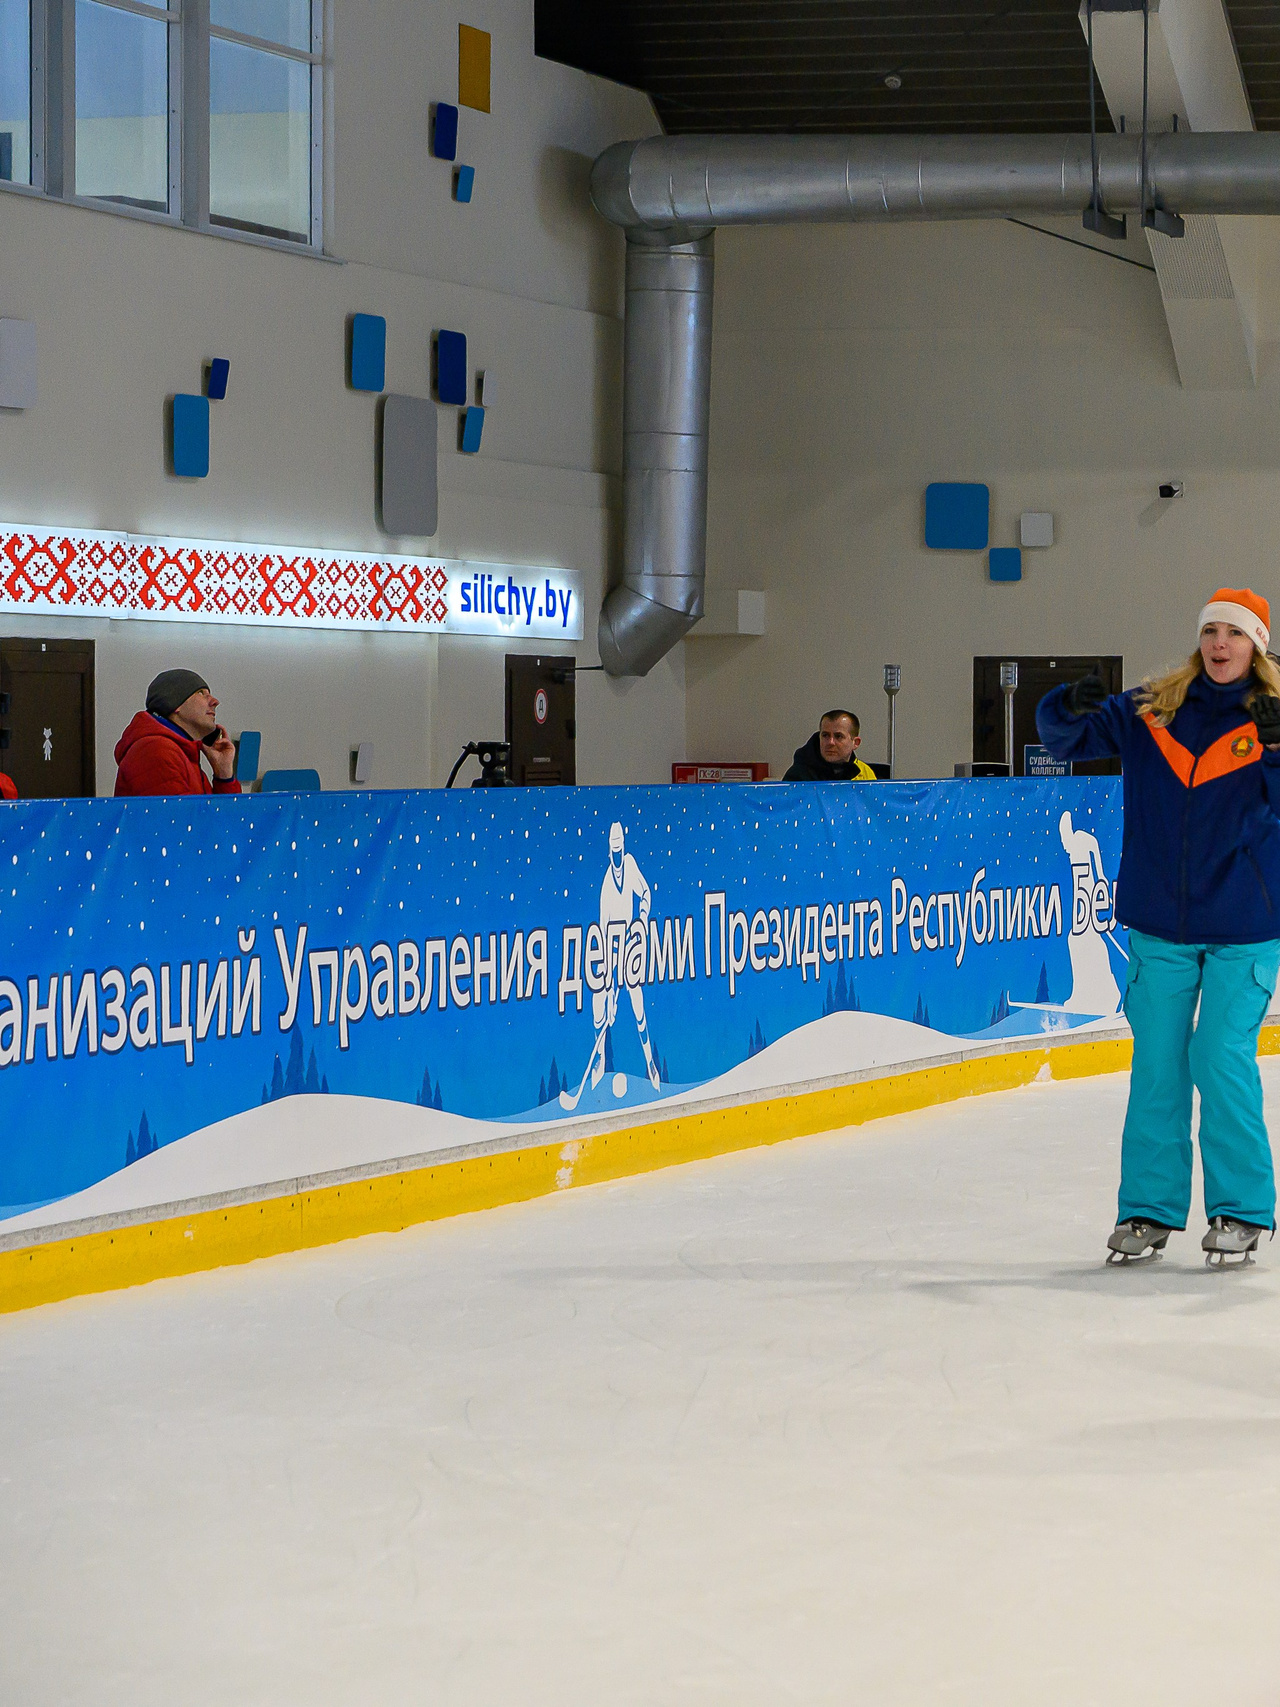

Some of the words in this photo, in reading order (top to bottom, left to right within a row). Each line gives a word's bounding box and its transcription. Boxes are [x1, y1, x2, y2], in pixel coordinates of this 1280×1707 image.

[461, 573, 572, 627] silichy.by
[1031, 766, 1065, 776] КОЛЛЕГИЯ
[0, 927, 261, 1068] анизаций
[273, 923, 548, 1051] Управления
[558, 915, 696, 1015] делами
[704, 890, 883, 997] Президента
[891, 866, 1062, 969] Республики
